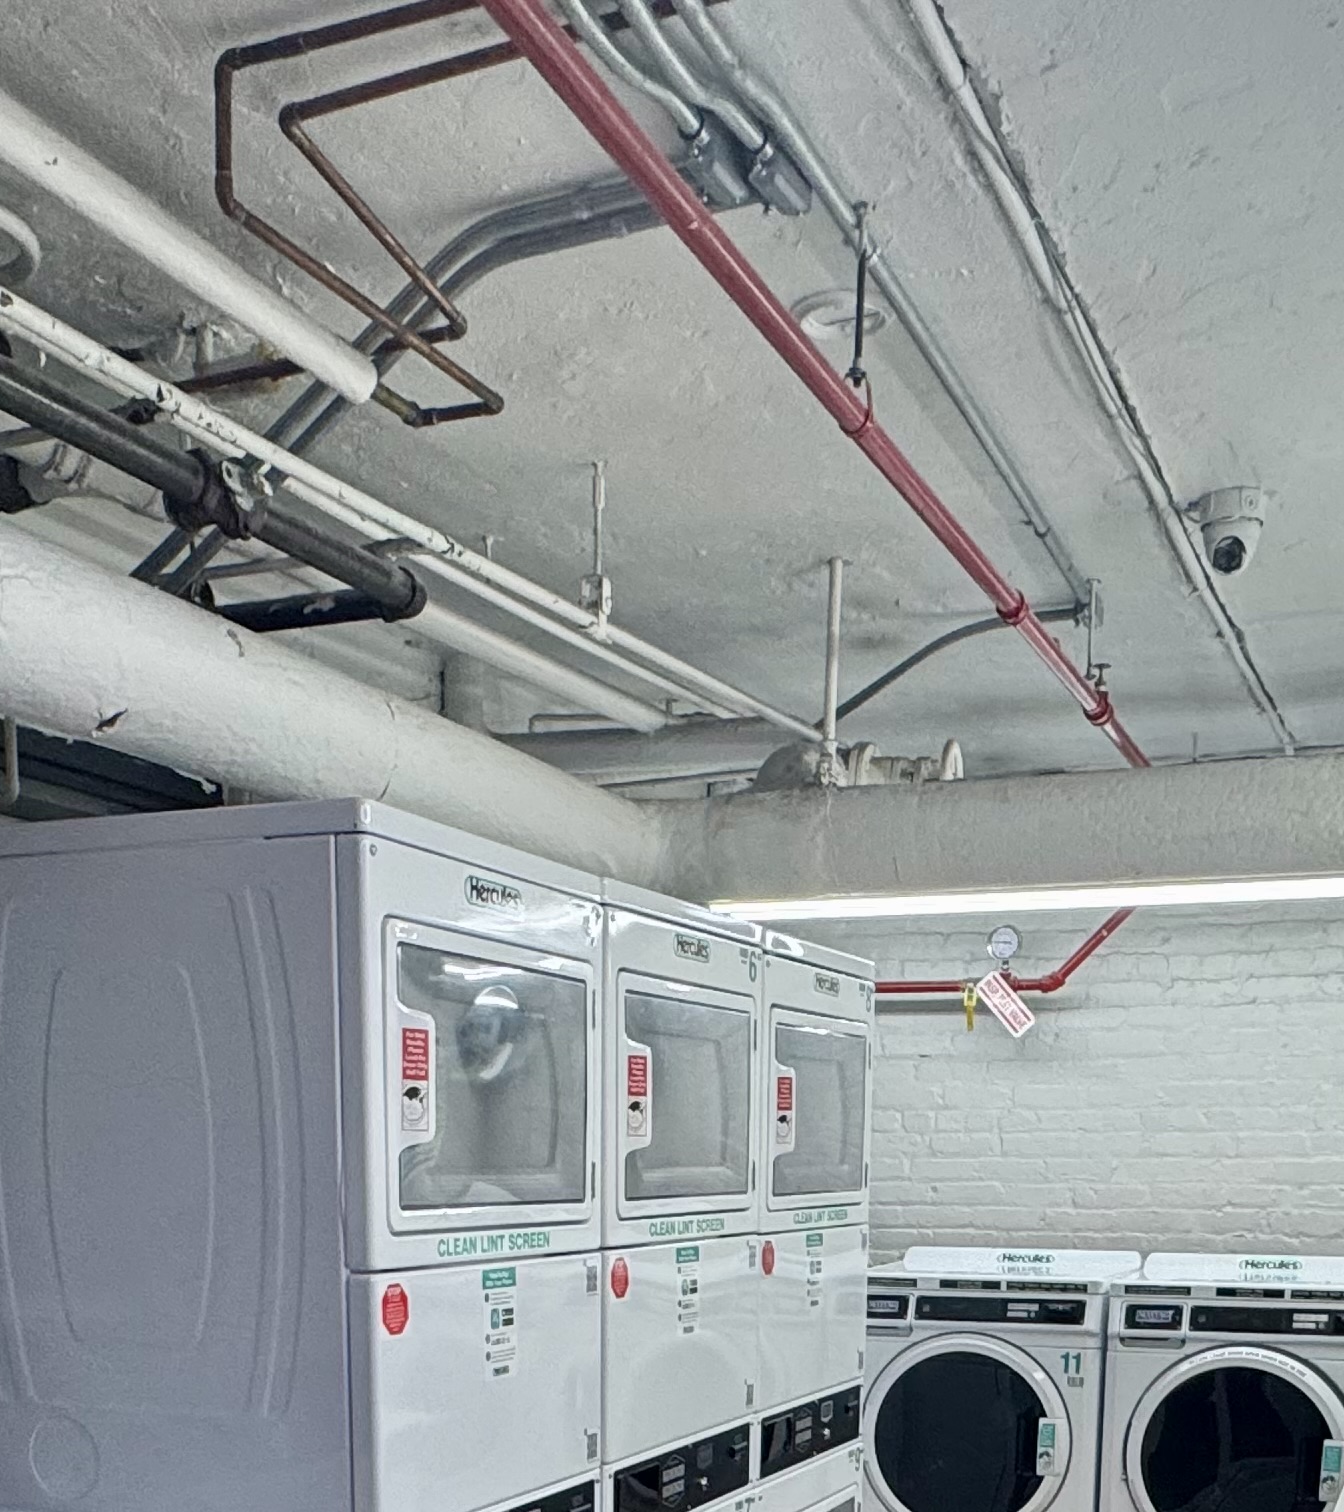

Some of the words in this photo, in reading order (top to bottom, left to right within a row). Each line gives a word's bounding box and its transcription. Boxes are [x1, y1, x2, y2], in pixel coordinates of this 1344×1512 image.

[676, 934, 709, 958] Hercules
[749, 951, 756, 982] 6
[866, 986, 872, 1012] 8
[649, 1222, 676, 1237] CLEAN
[677, 1220, 693, 1234] LINT
[696, 1218, 725, 1232] SCREEN
[793, 1212, 813, 1224] CLEAN
[814, 1211, 826, 1223] LINT
[827, 1209, 848, 1221] SCREEN
[437, 1237, 478, 1257] CLEAN
[480, 1234, 506, 1253] LINT
[508, 1231, 550, 1250] SCREEN
[1002, 1253, 1053, 1264] Hercules
[1244, 1259, 1299, 1270] Hercules
[1061, 1352, 1081, 1374] 11
[855, 1447, 861, 1472] 9
